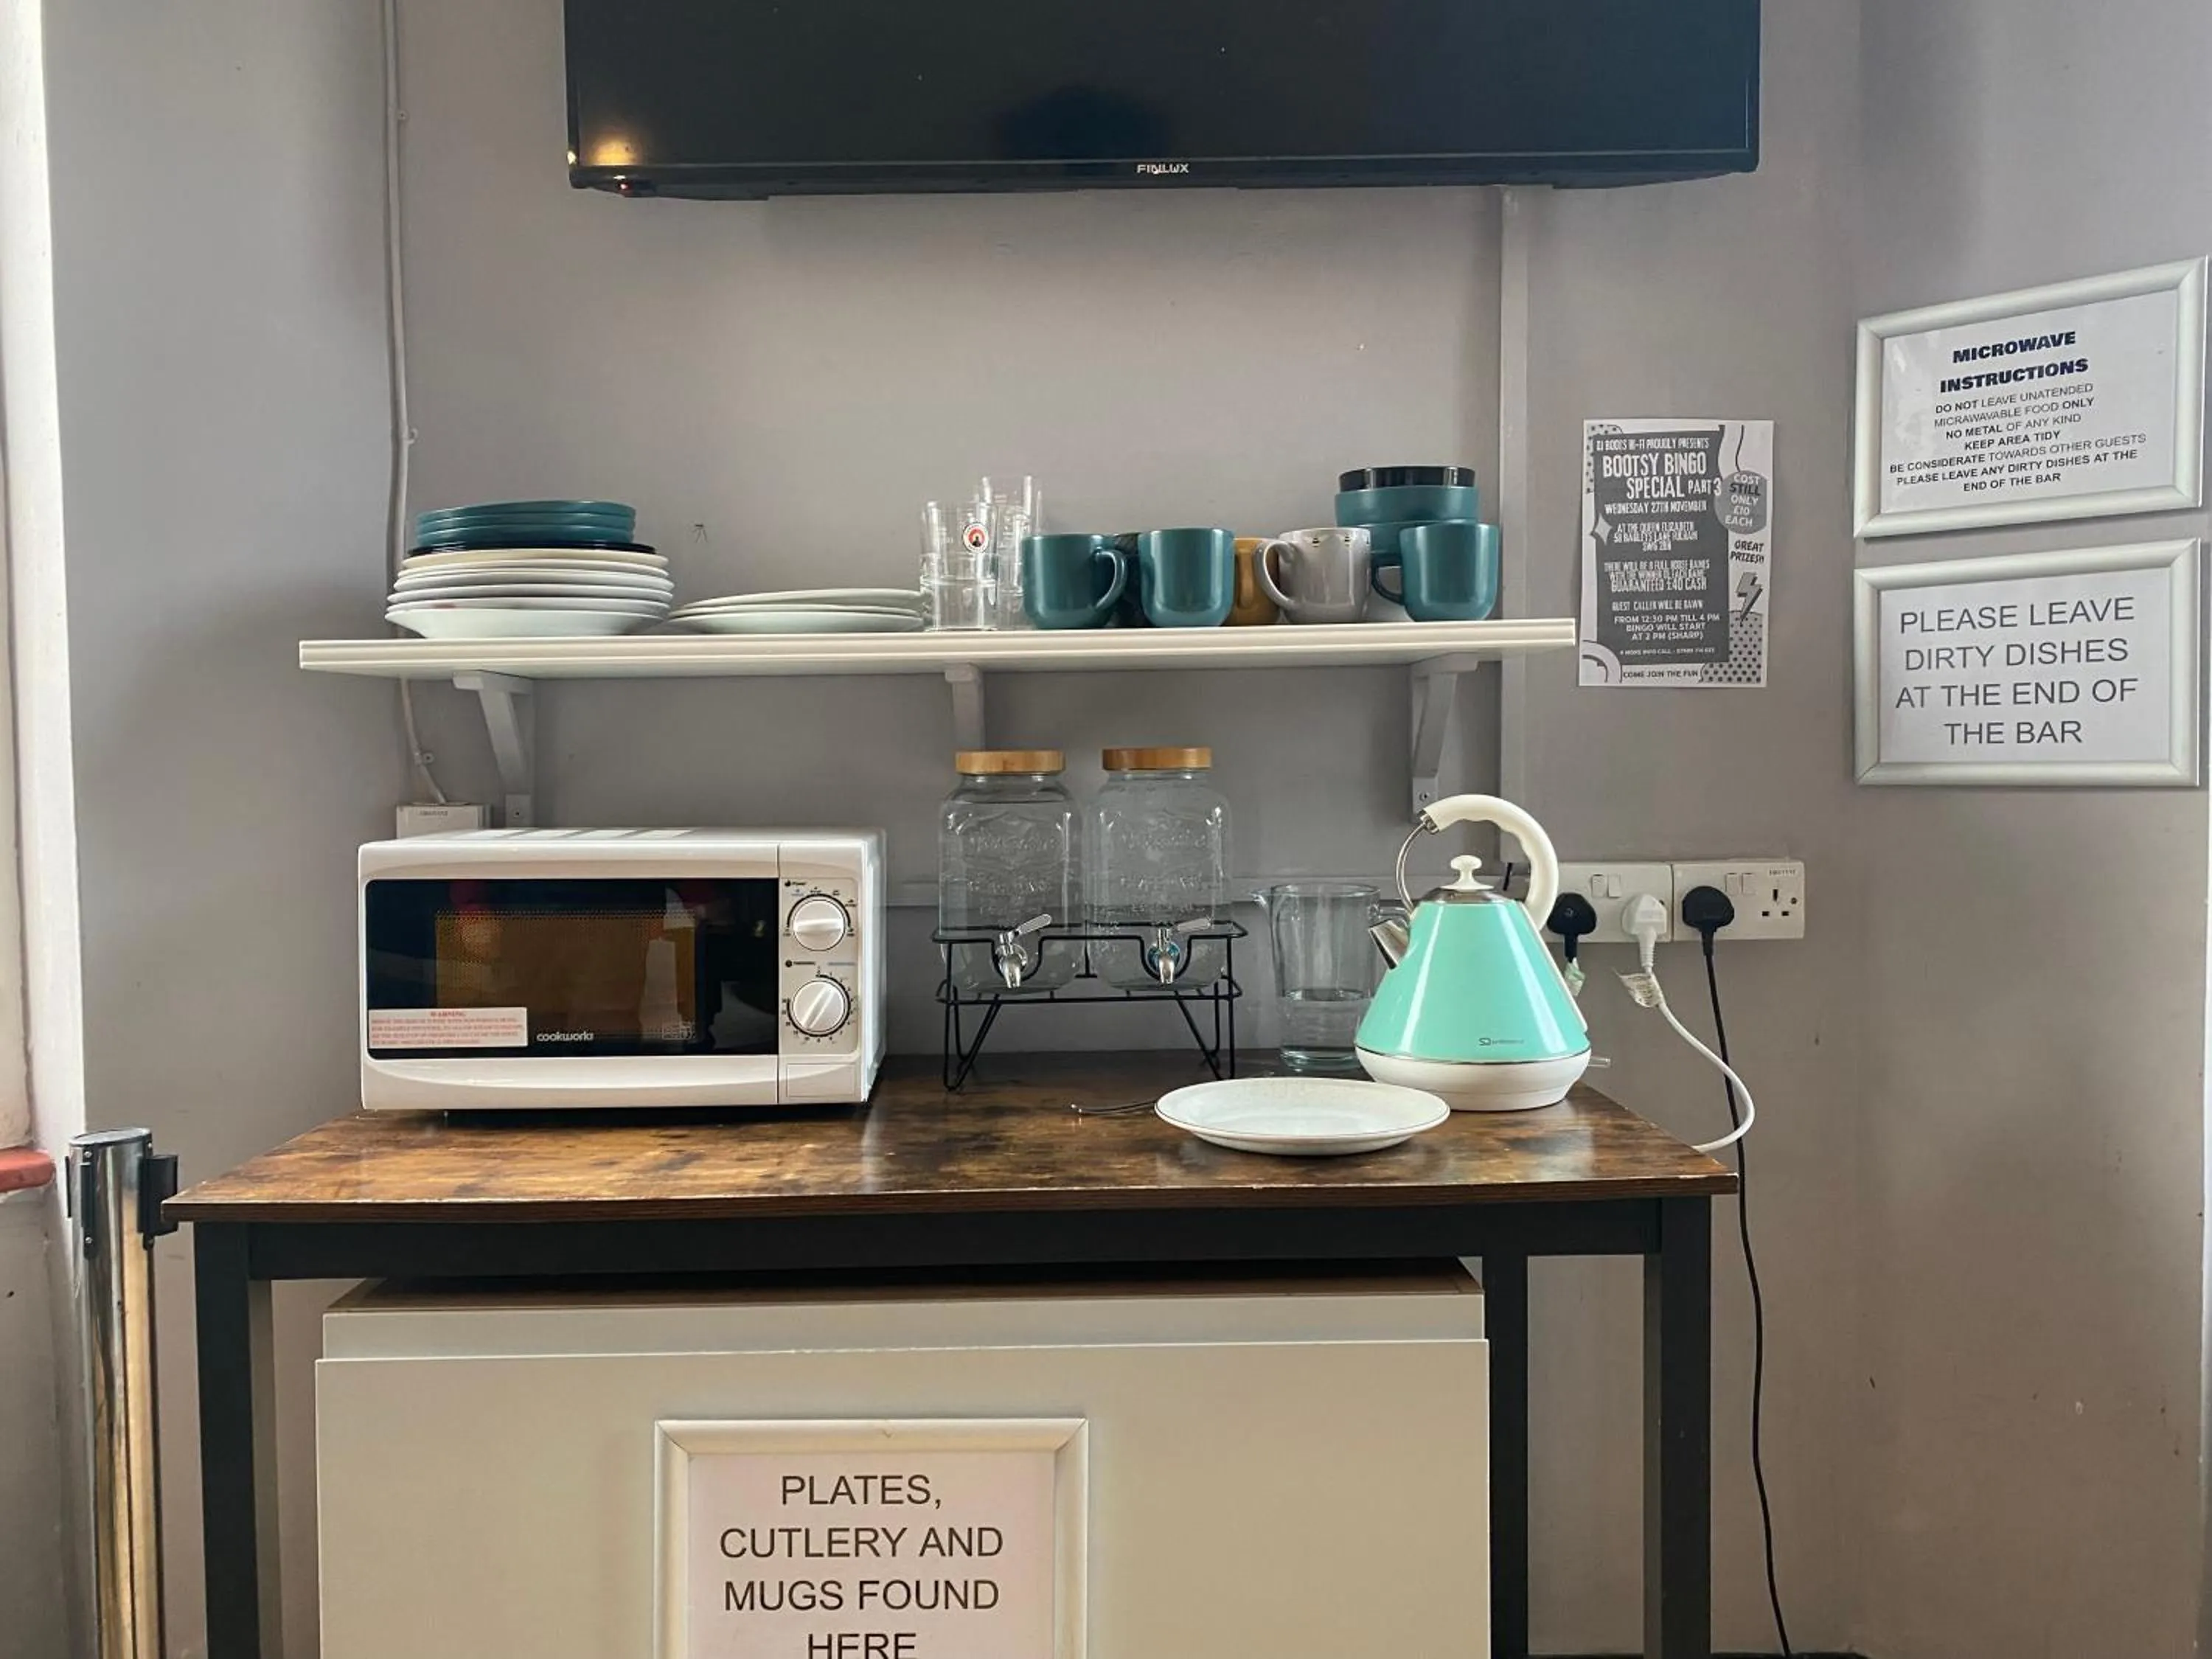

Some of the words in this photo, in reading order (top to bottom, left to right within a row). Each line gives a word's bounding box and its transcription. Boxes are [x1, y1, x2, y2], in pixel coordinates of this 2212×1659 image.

[1136, 163, 1189, 174] FINLUX
[1952, 331, 2076, 364] MICROWAVE
[1940, 358, 2090, 394] INSTRUCTIONS
[1935, 403, 1952, 414] DO
[1955, 399, 1979, 411] NOT
[1981, 394, 2017, 408] LEAVE
[2020, 383, 2094, 402] UNATENDED
[1934, 407, 2022, 428] MICRAWAVABLE
[2025, 402, 2059, 415] FOOD
[2062, 397, 2095, 410] ONLY
[1946, 430, 1962, 440] NO
[1965, 425, 2003, 437] METAL
[2006, 421, 2022, 431] OF
[2025, 418, 2050, 429] ANY
[2052, 414, 2081, 425] KIND
[1890, 463, 1905, 473] BE
[1907, 453, 1986, 472] CONSIDERATE
[1989, 446, 2047, 462] TOWARDS
[2049, 440, 2092, 454] OTHER
[2095, 433, 2147, 448] GUESTS
[1964, 439, 1995, 451] KEEP
[1997, 434, 2031, 447] AREA
[2033, 430, 2061, 442] TIDY
[1602, 452, 1659, 478] BOOTSY
[1664, 451, 1707, 476] BINGO
[1896, 473, 1938, 486] PLEASE
[1941, 468, 1979, 481] LEAVE
[1980, 465, 2005, 477] ANY
[2008, 460, 2043, 473] DIRTY
[2046, 455, 2090, 469] DISHES
[2093, 452, 2110, 463] AT
[2112, 449, 2138, 461] THE
[1626, 476, 1685, 500] SPECIAL
[1688, 479, 1712, 495] PART
[1714, 477, 1722, 496] 3
[1729, 483, 1761, 496] STILL
[1733, 474, 1760, 485] COST
[1964, 481, 1986, 492] END
[1989, 479, 2006, 489] OF
[2008, 476, 2033, 487] THE
[2035, 473, 2062, 484] BAR
[1604, 501, 1649, 515] WEDNESDAY
[1670, 499, 1707, 512] NOVEMBER
[1731, 494, 1759, 507] ONLY
[1725, 514, 1753, 527] EACH
[1734, 540, 1764, 553] GREAT
[1685, 577, 1707, 591] CASH
[1614, 615, 1639, 625] FROM
[1641, 615, 1663, 624] 12:30
[1666, 614, 1677, 623] PM
[1680, 614, 1697, 622] TILL
[1699, 613, 1705, 622] 4
[1707, 613, 1720, 622] PM
[1626, 624, 1654, 632] BINGO
[1656, 622, 1677, 631] WILL
[1679, 622, 1706, 630] START
[1900, 605, 2019, 634] PLEASE
[2029, 597, 2135, 626] LEAVE
[1632, 633, 1643, 641] AT
[1652, 632, 1666, 641] PM
[1668, 631, 1704, 641] (SHARP)
[1905, 644, 1995, 671] DIRTY
[2006, 637, 2129, 666] DISHES
[1895, 686, 1931, 709] AT
[1941, 684, 2002, 707] THE
[2012, 681, 2080, 705] END
[2091, 678, 2138, 703] OF
[1944, 722, 2005, 745] THE
[2016, 720, 2083, 745] BAR
[781, 1475, 942, 1509] PLATES,
[720, 1527, 908, 1559] CUTLERY
[919, 1527, 1004, 1558] AND
[724, 1579, 844, 1611] MUGS
[859, 1579, 1000, 1611] FOUND
[807, 1632, 917, 1659] HERE
